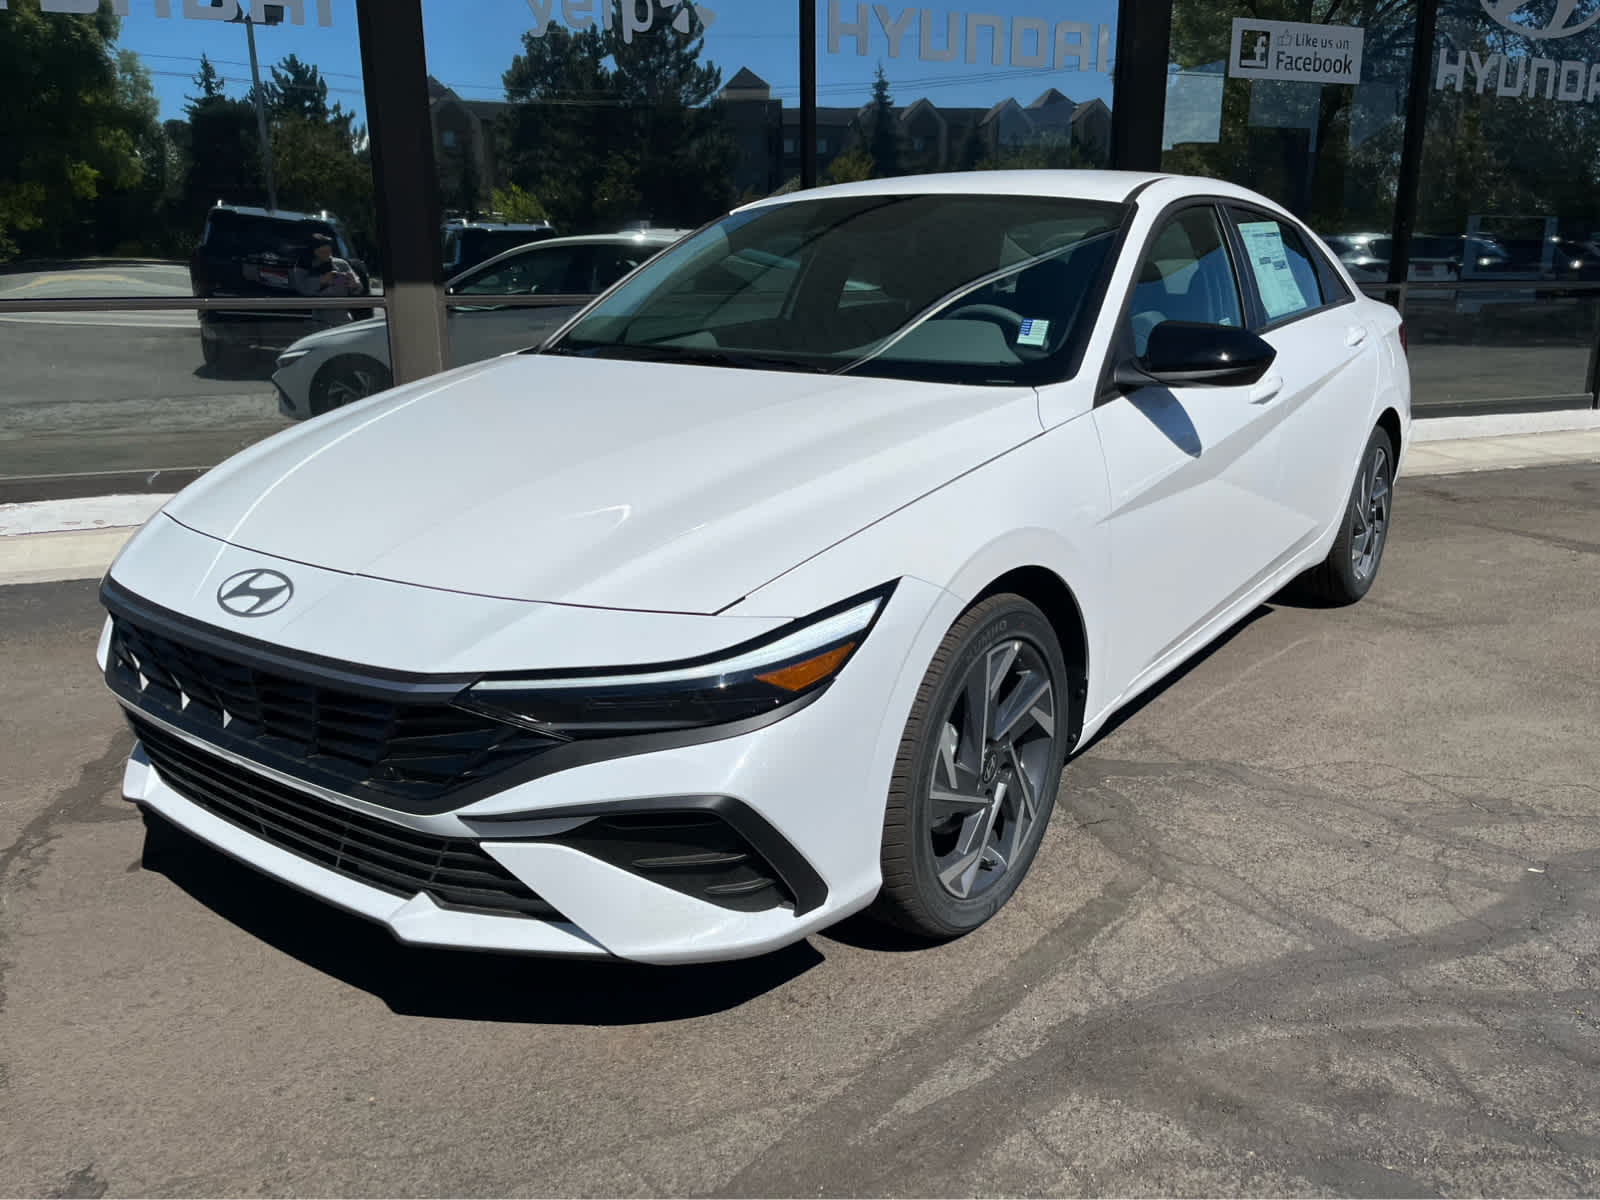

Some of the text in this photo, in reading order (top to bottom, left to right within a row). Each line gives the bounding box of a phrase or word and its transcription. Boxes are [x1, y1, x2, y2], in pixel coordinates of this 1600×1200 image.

[827, 0, 1109, 73] HYUNDAI
[1295, 31, 1350, 50] Like us on
[1276, 50, 1353, 75] Facebook
